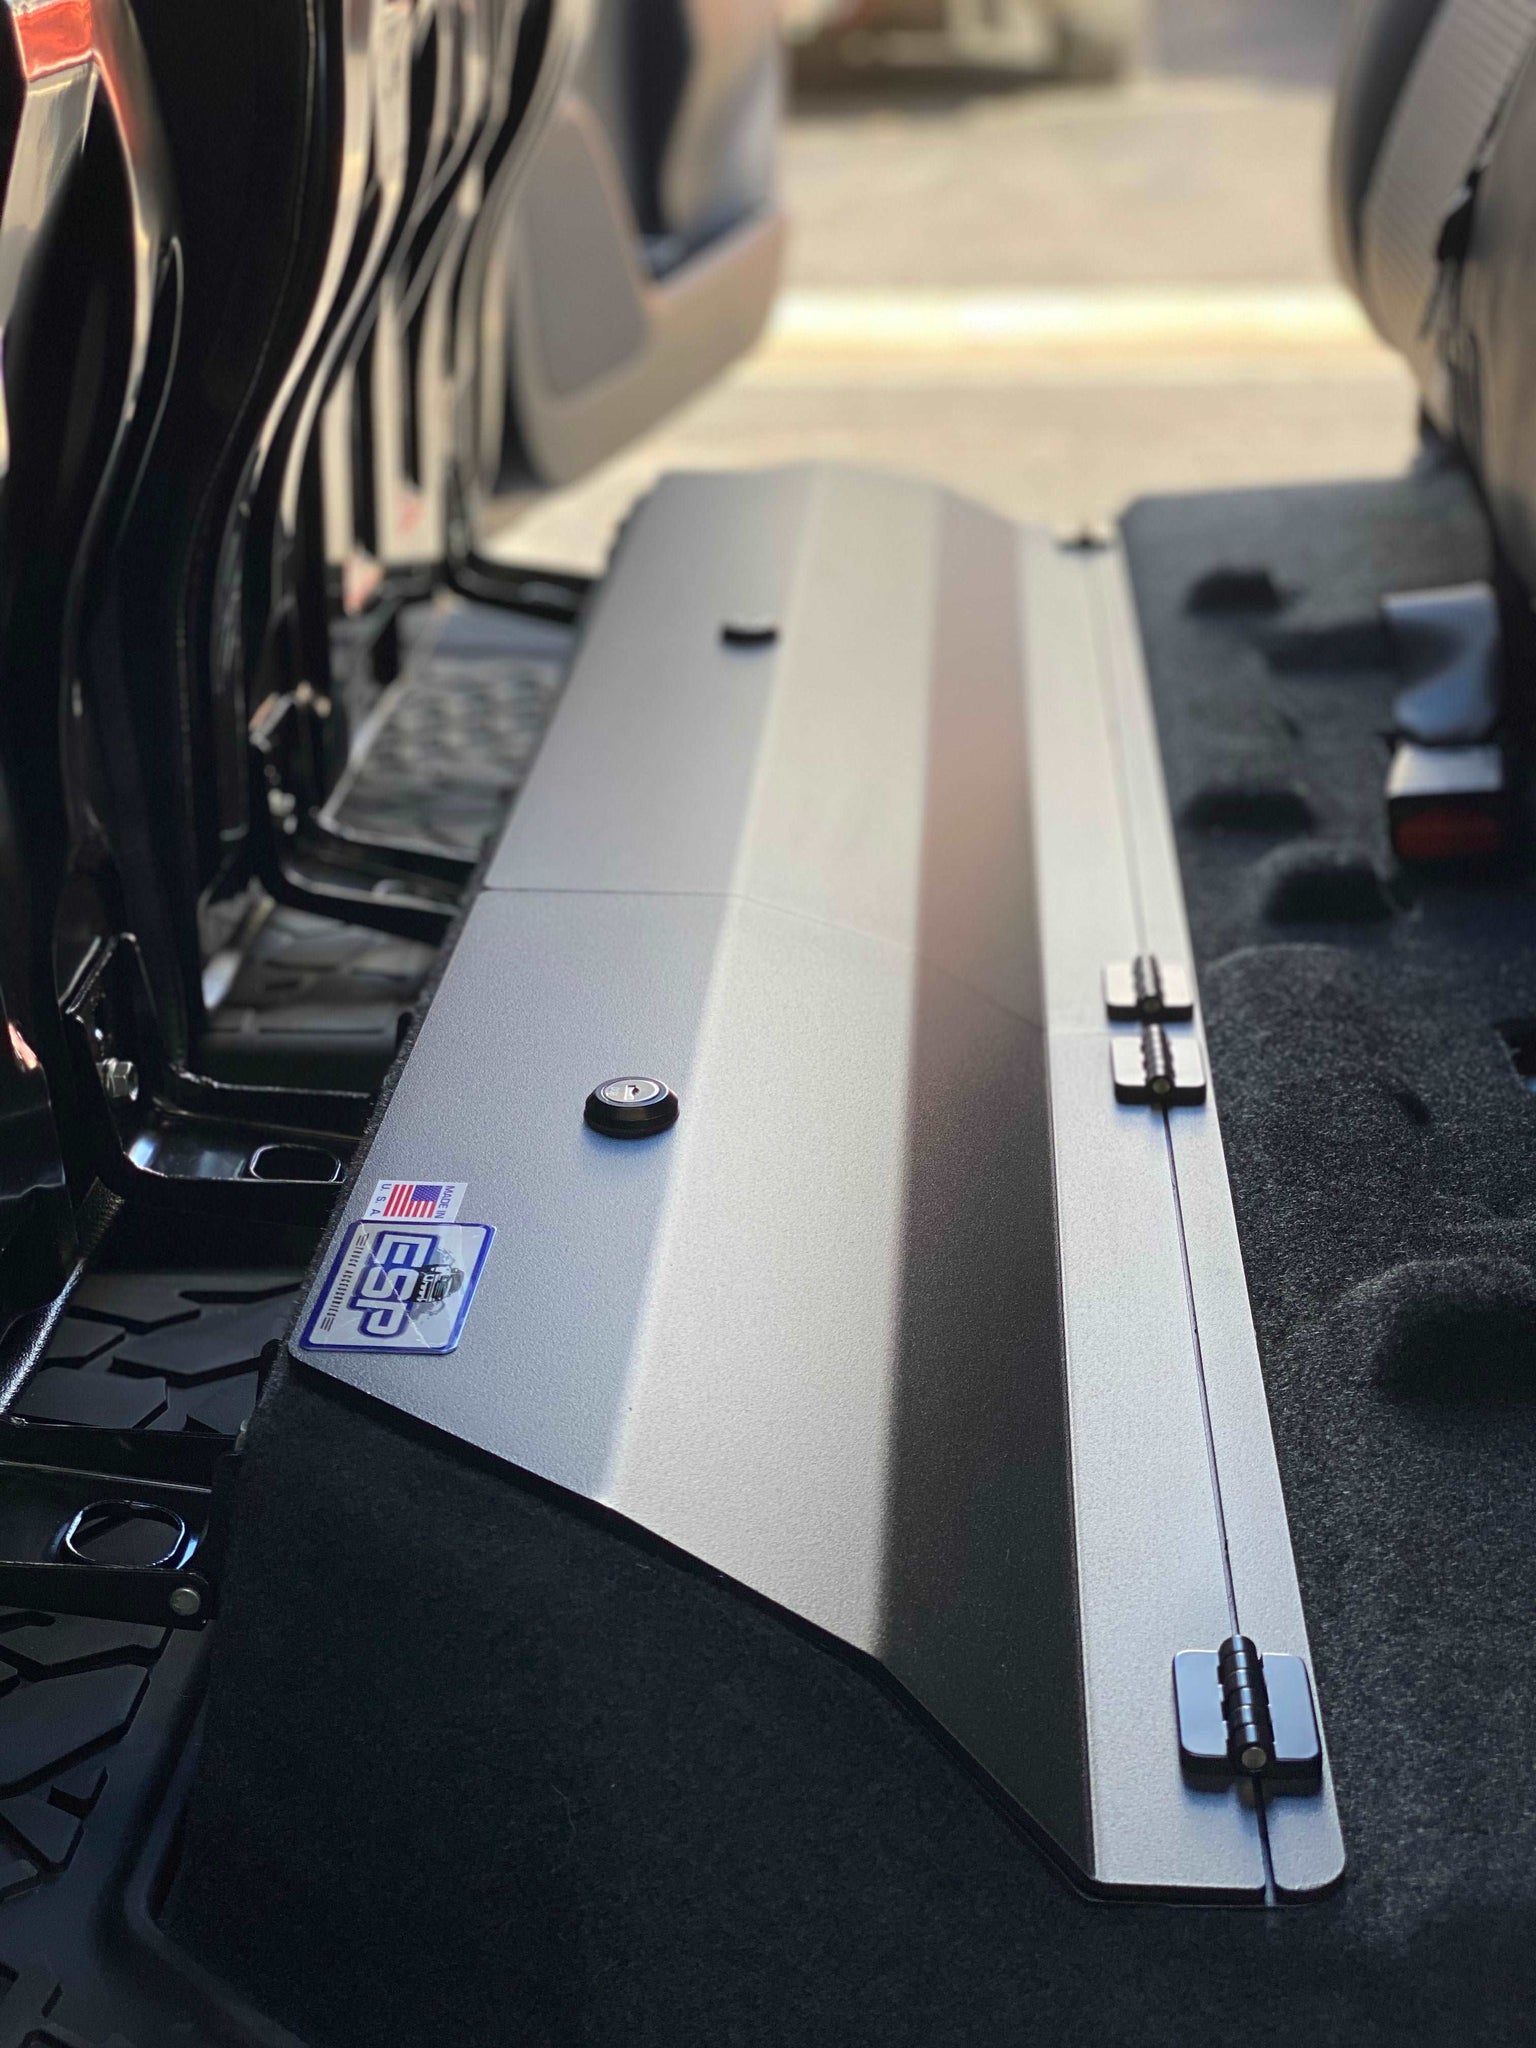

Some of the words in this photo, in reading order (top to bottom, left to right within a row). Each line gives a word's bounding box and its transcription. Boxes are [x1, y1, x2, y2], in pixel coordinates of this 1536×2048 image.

[438, 1185, 456, 1209] MADE
[434, 1210, 446, 1219] IN
[353, 1232, 436, 1336] ESP
